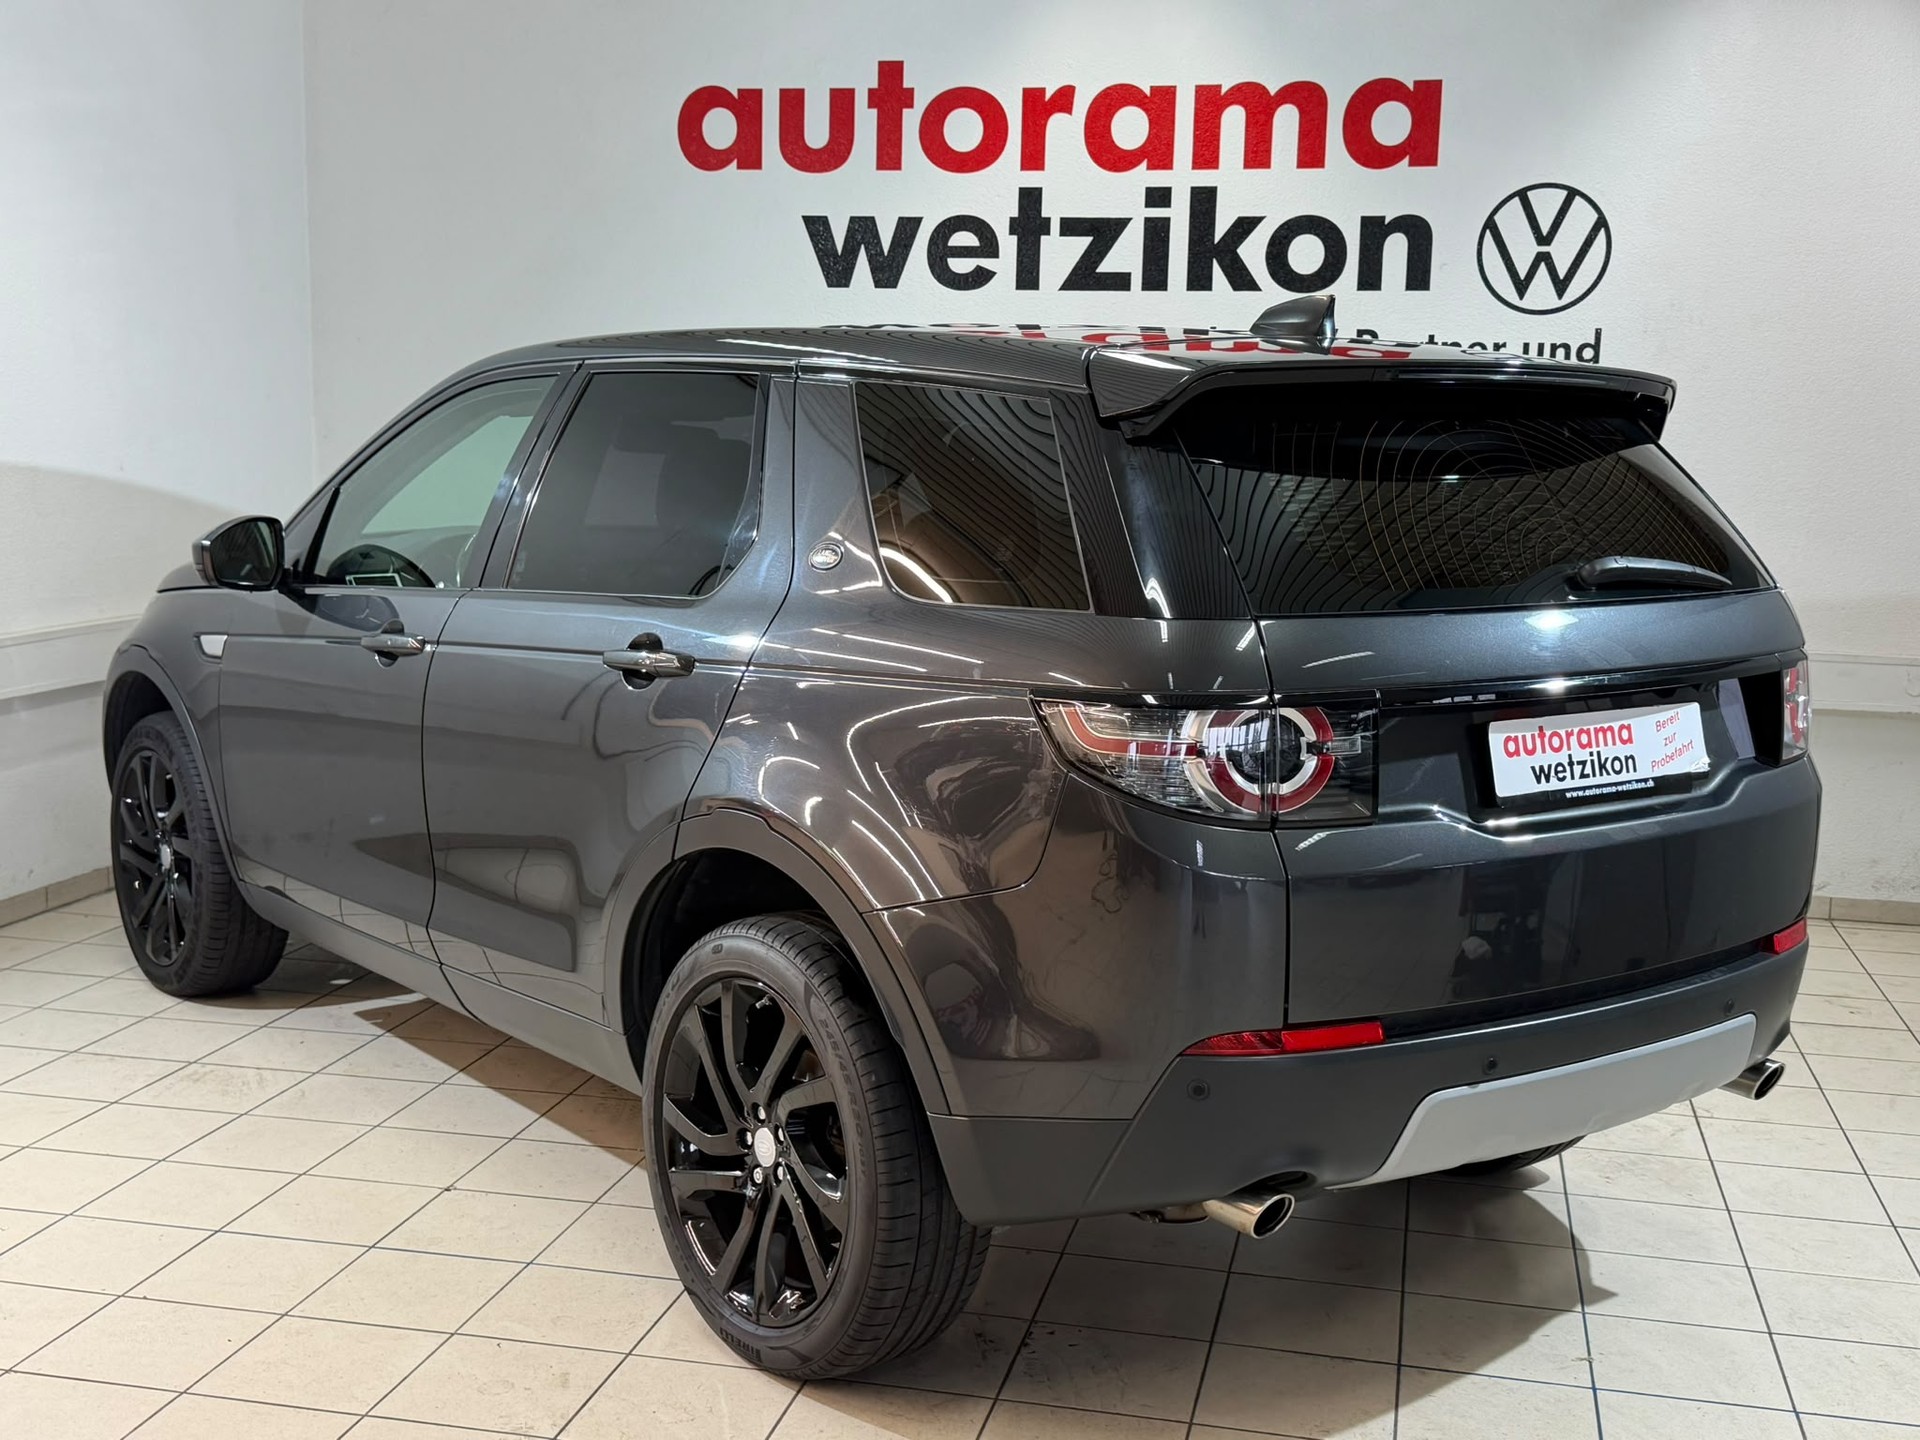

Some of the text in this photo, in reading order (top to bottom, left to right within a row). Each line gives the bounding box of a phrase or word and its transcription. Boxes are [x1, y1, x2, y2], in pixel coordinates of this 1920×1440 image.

[677, 60, 1444, 174] autorama
[801, 186, 1432, 292] wetzikon
[1655, 711, 1680, 732] Bereit
[1503, 723, 1635, 758] autorama
[1651, 739, 1694, 772] Probefahrt
[1663, 732, 1677, 747] zur
[1531, 750, 1638, 785] wetzikon
[1565, 778, 1655, 798] www.autorama-wetzikon.ch
